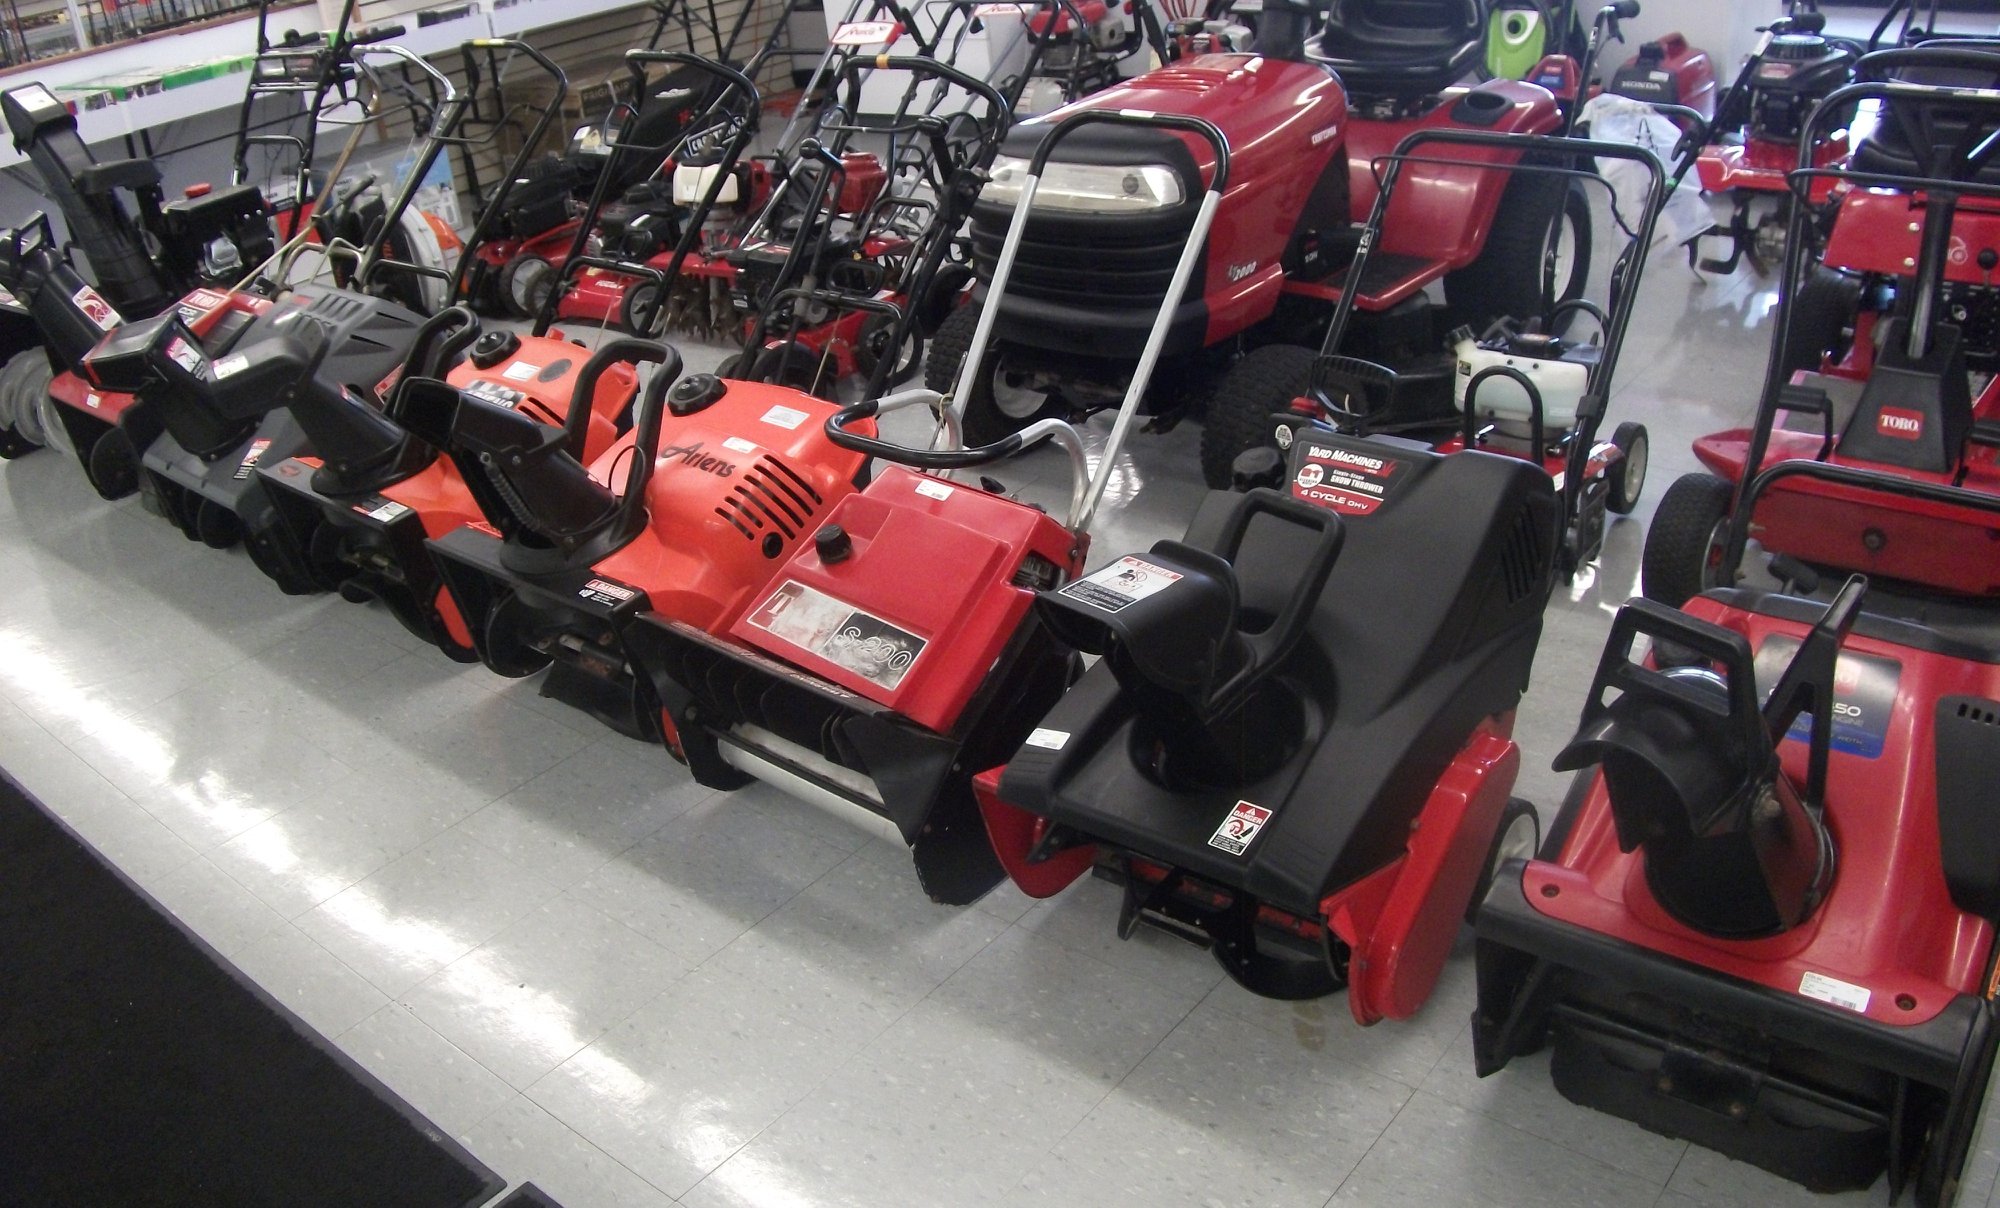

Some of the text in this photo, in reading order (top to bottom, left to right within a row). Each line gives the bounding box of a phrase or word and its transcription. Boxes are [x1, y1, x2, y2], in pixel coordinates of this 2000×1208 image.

[1621, 80, 1660, 91] HONDA
[1881, 414, 1919, 432] TORO
[661, 442, 736, 478] Ariens
[1308, 446, 1383, 470] YARD MACHINES
[1330, 475, 1384, 494] SNOW THROWER
[1310, 491, 1346, 504] CYCLE
[1233, 810, 1263, 825] DANGER
